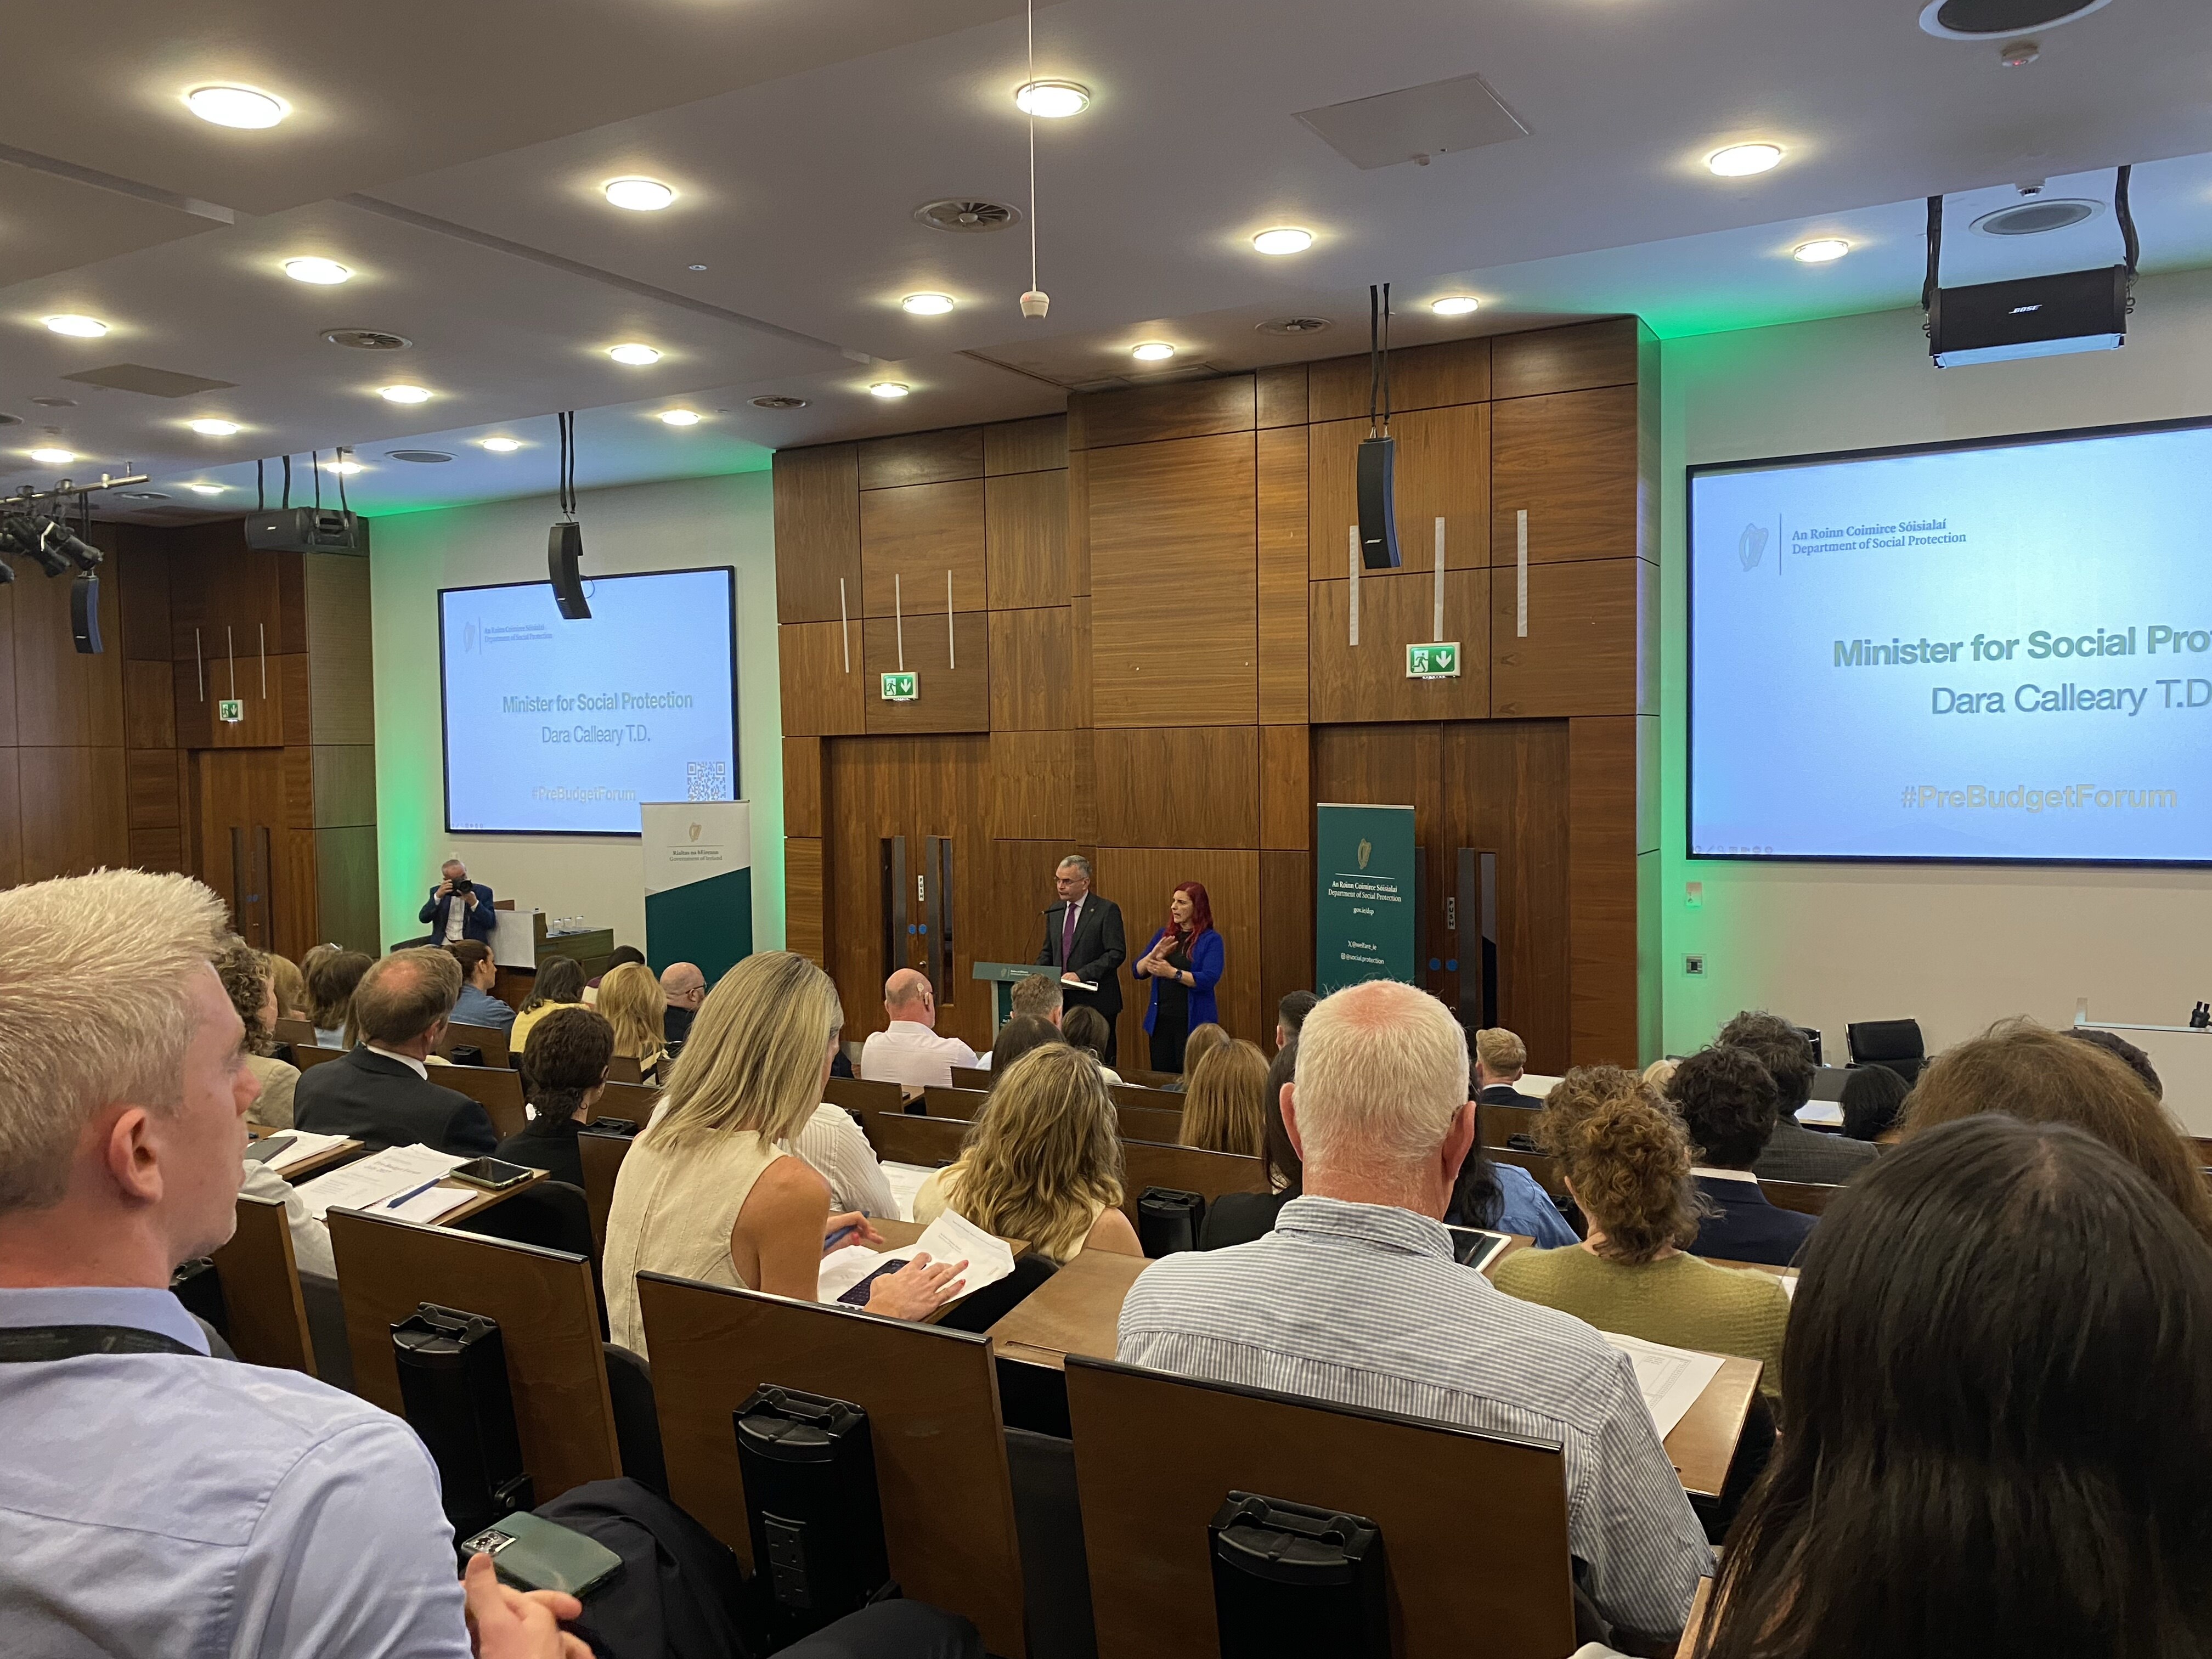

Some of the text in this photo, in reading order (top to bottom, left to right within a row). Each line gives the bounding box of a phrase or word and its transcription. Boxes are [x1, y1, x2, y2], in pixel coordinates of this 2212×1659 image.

[1792, 518, 1946, 541] An Roinn Coimirce Sóisialaí
[1792, 532, 1967, 556] Department of Social Protection
[1835, 625, 2212, 667] Minister for Social Pro
[503, 691, 693, 713] Minister for Social Protection
[1932, 687, 2005, 714] Dara
[2015, 683, 2148, 716] Calleary
[542, 724, 651, 746] Dara Calleary T.D.
[532, 786, 636, 803] #PreBudgetForum
[1901, 784, 2177, 814] #PreBudgetForum
[1328, 888, 1356, 898] Department
[1376, 893, 1402, 902] Protection
[1339, 881, 1354, 889] Roinn
